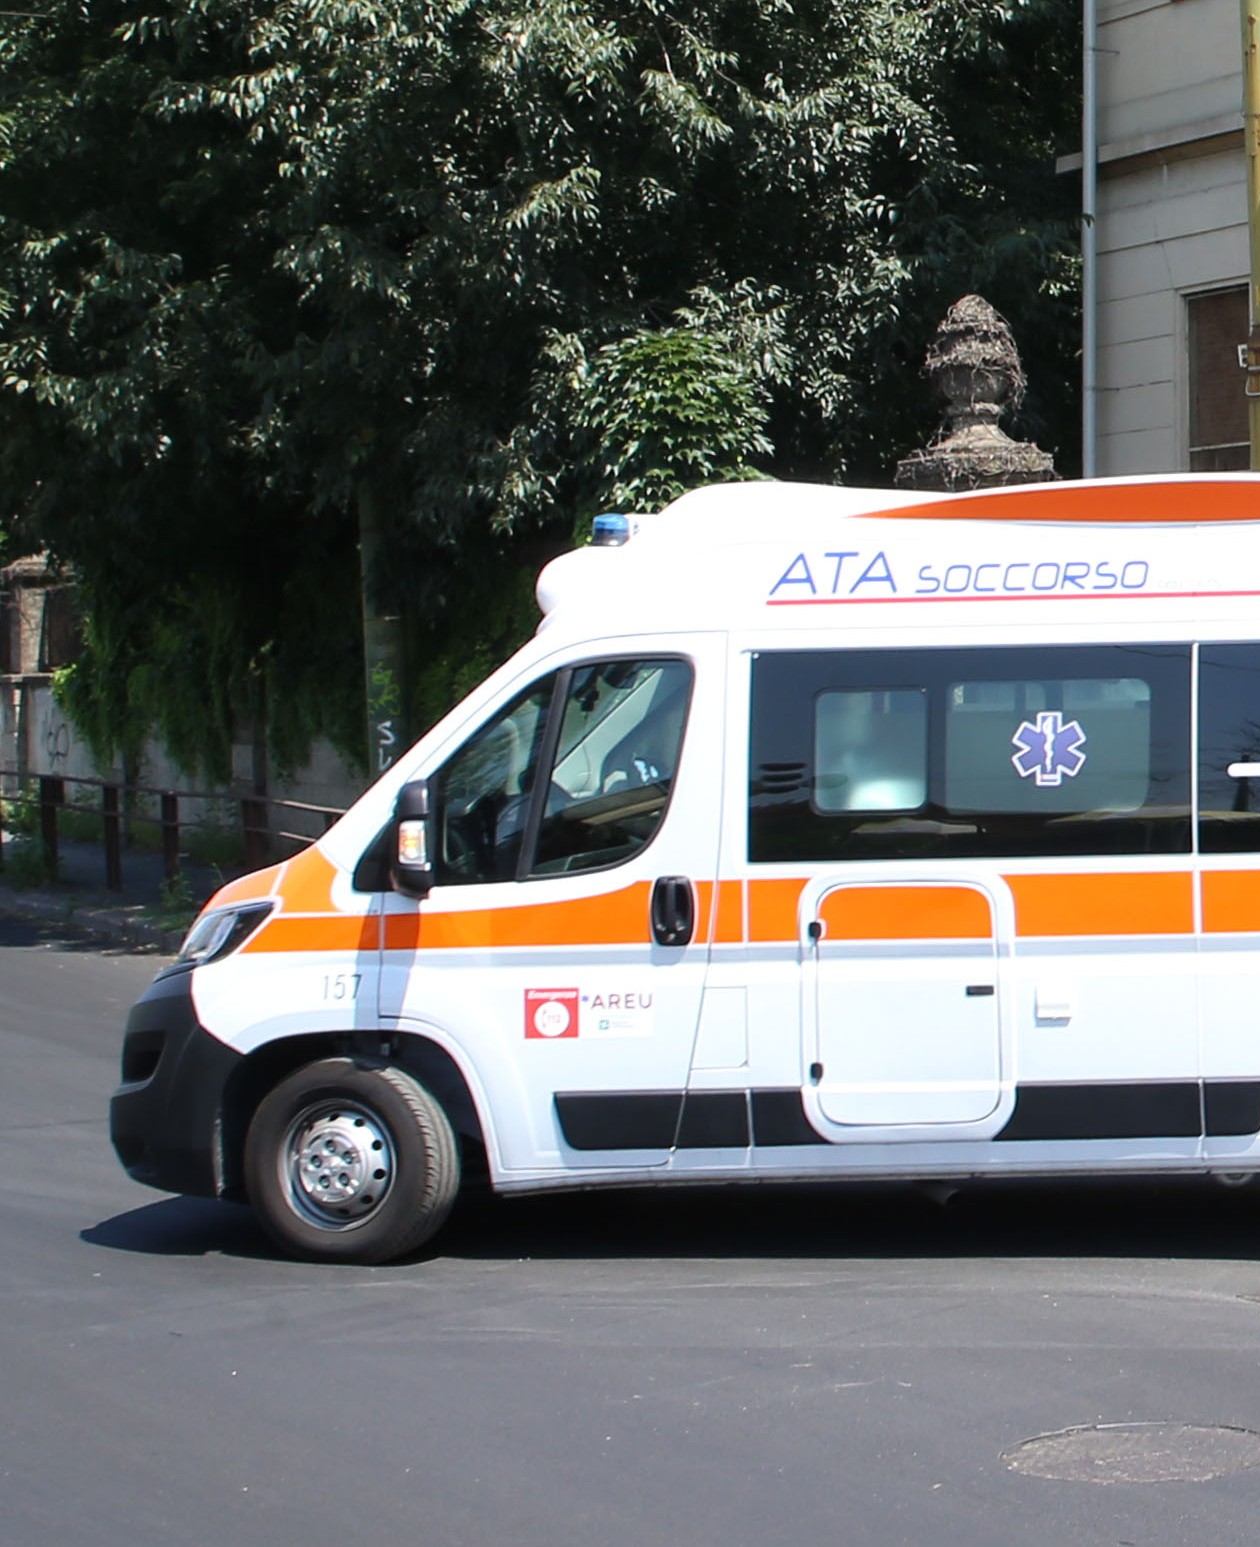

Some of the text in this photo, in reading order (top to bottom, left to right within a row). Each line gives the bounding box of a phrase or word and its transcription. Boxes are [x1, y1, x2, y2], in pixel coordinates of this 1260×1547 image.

[769, 551, 1150, 595] ATA SOCCORSO
[323, 974, 362, 1000] 157
[590, 993, 653, 1010] AREU
